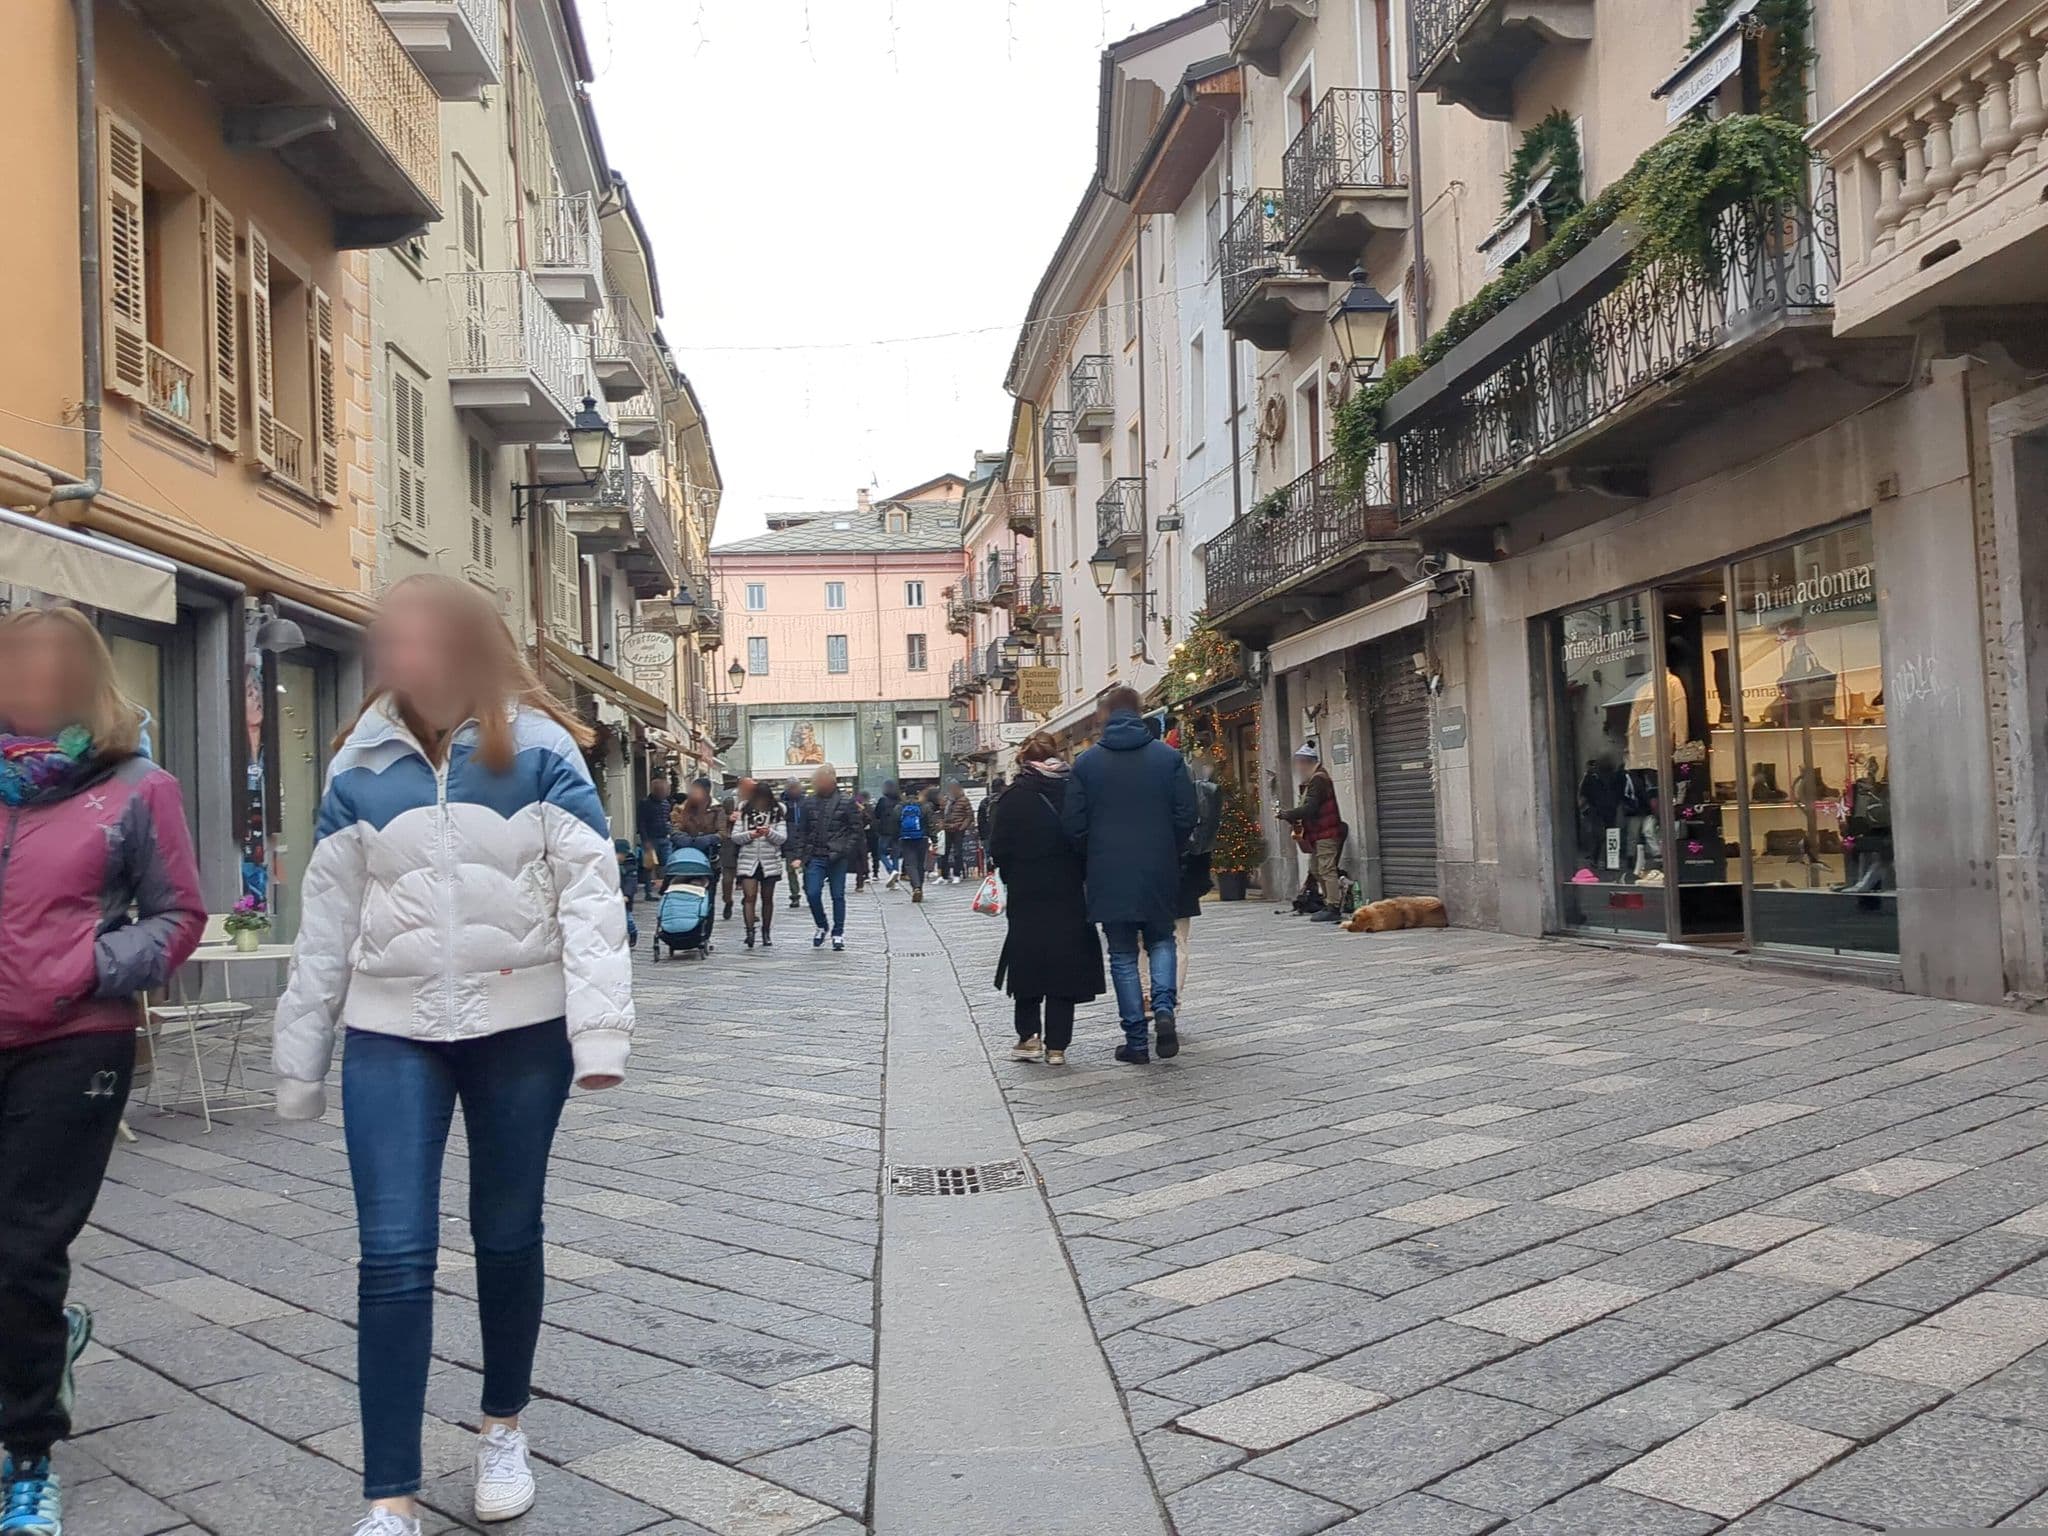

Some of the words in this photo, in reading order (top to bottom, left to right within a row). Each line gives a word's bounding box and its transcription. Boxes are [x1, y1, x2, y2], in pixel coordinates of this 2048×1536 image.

[1755, 564, 1872, 626] primadonna
[1809, 591, 1872, 615] COLLECTION
[627, 634, 670, 648] Trattoria
[1562, 625, 1635, 673] primadonna
[631, 651, 665, 663] Artisti
[1595, 649, 1635, 664] COLLECTION
